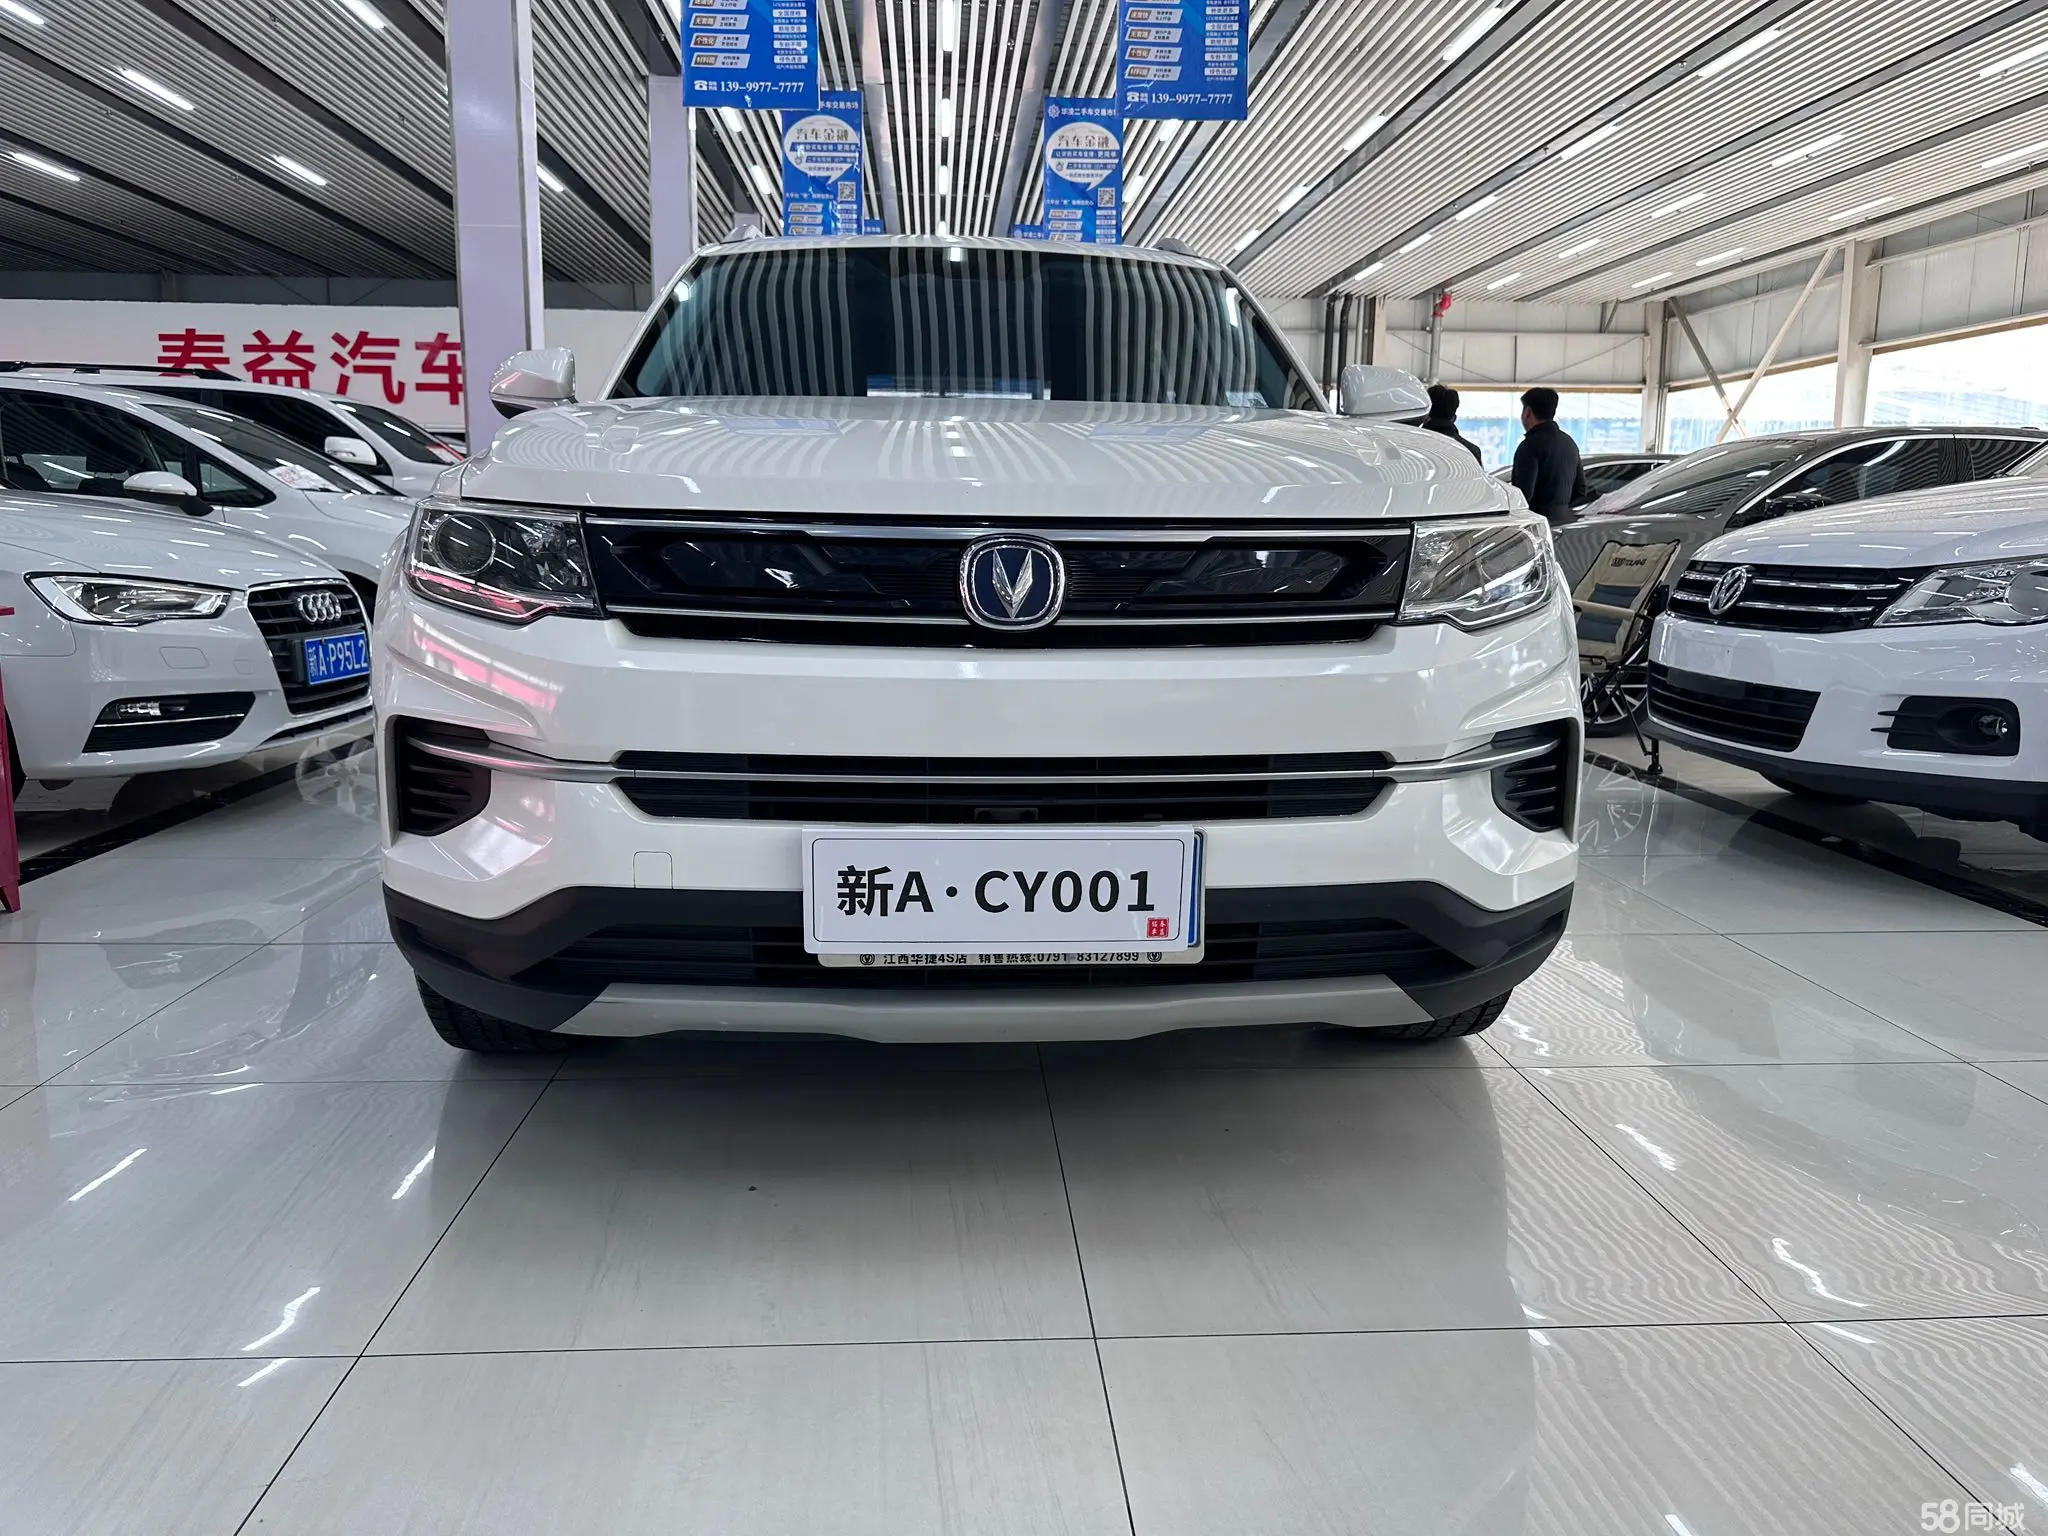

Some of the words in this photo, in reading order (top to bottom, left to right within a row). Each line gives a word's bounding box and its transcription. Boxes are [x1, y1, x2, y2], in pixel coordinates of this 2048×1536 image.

[720, 81, 804, 93] 139-9977-7777
[1152, 93, 1233, 104] 139-9977-7777
[796, 128, 849, 141] 汽车金融
[1057, 135, 1109, 148] 汽车金融
[836, 865, 1155, 917] 新A·CY001
